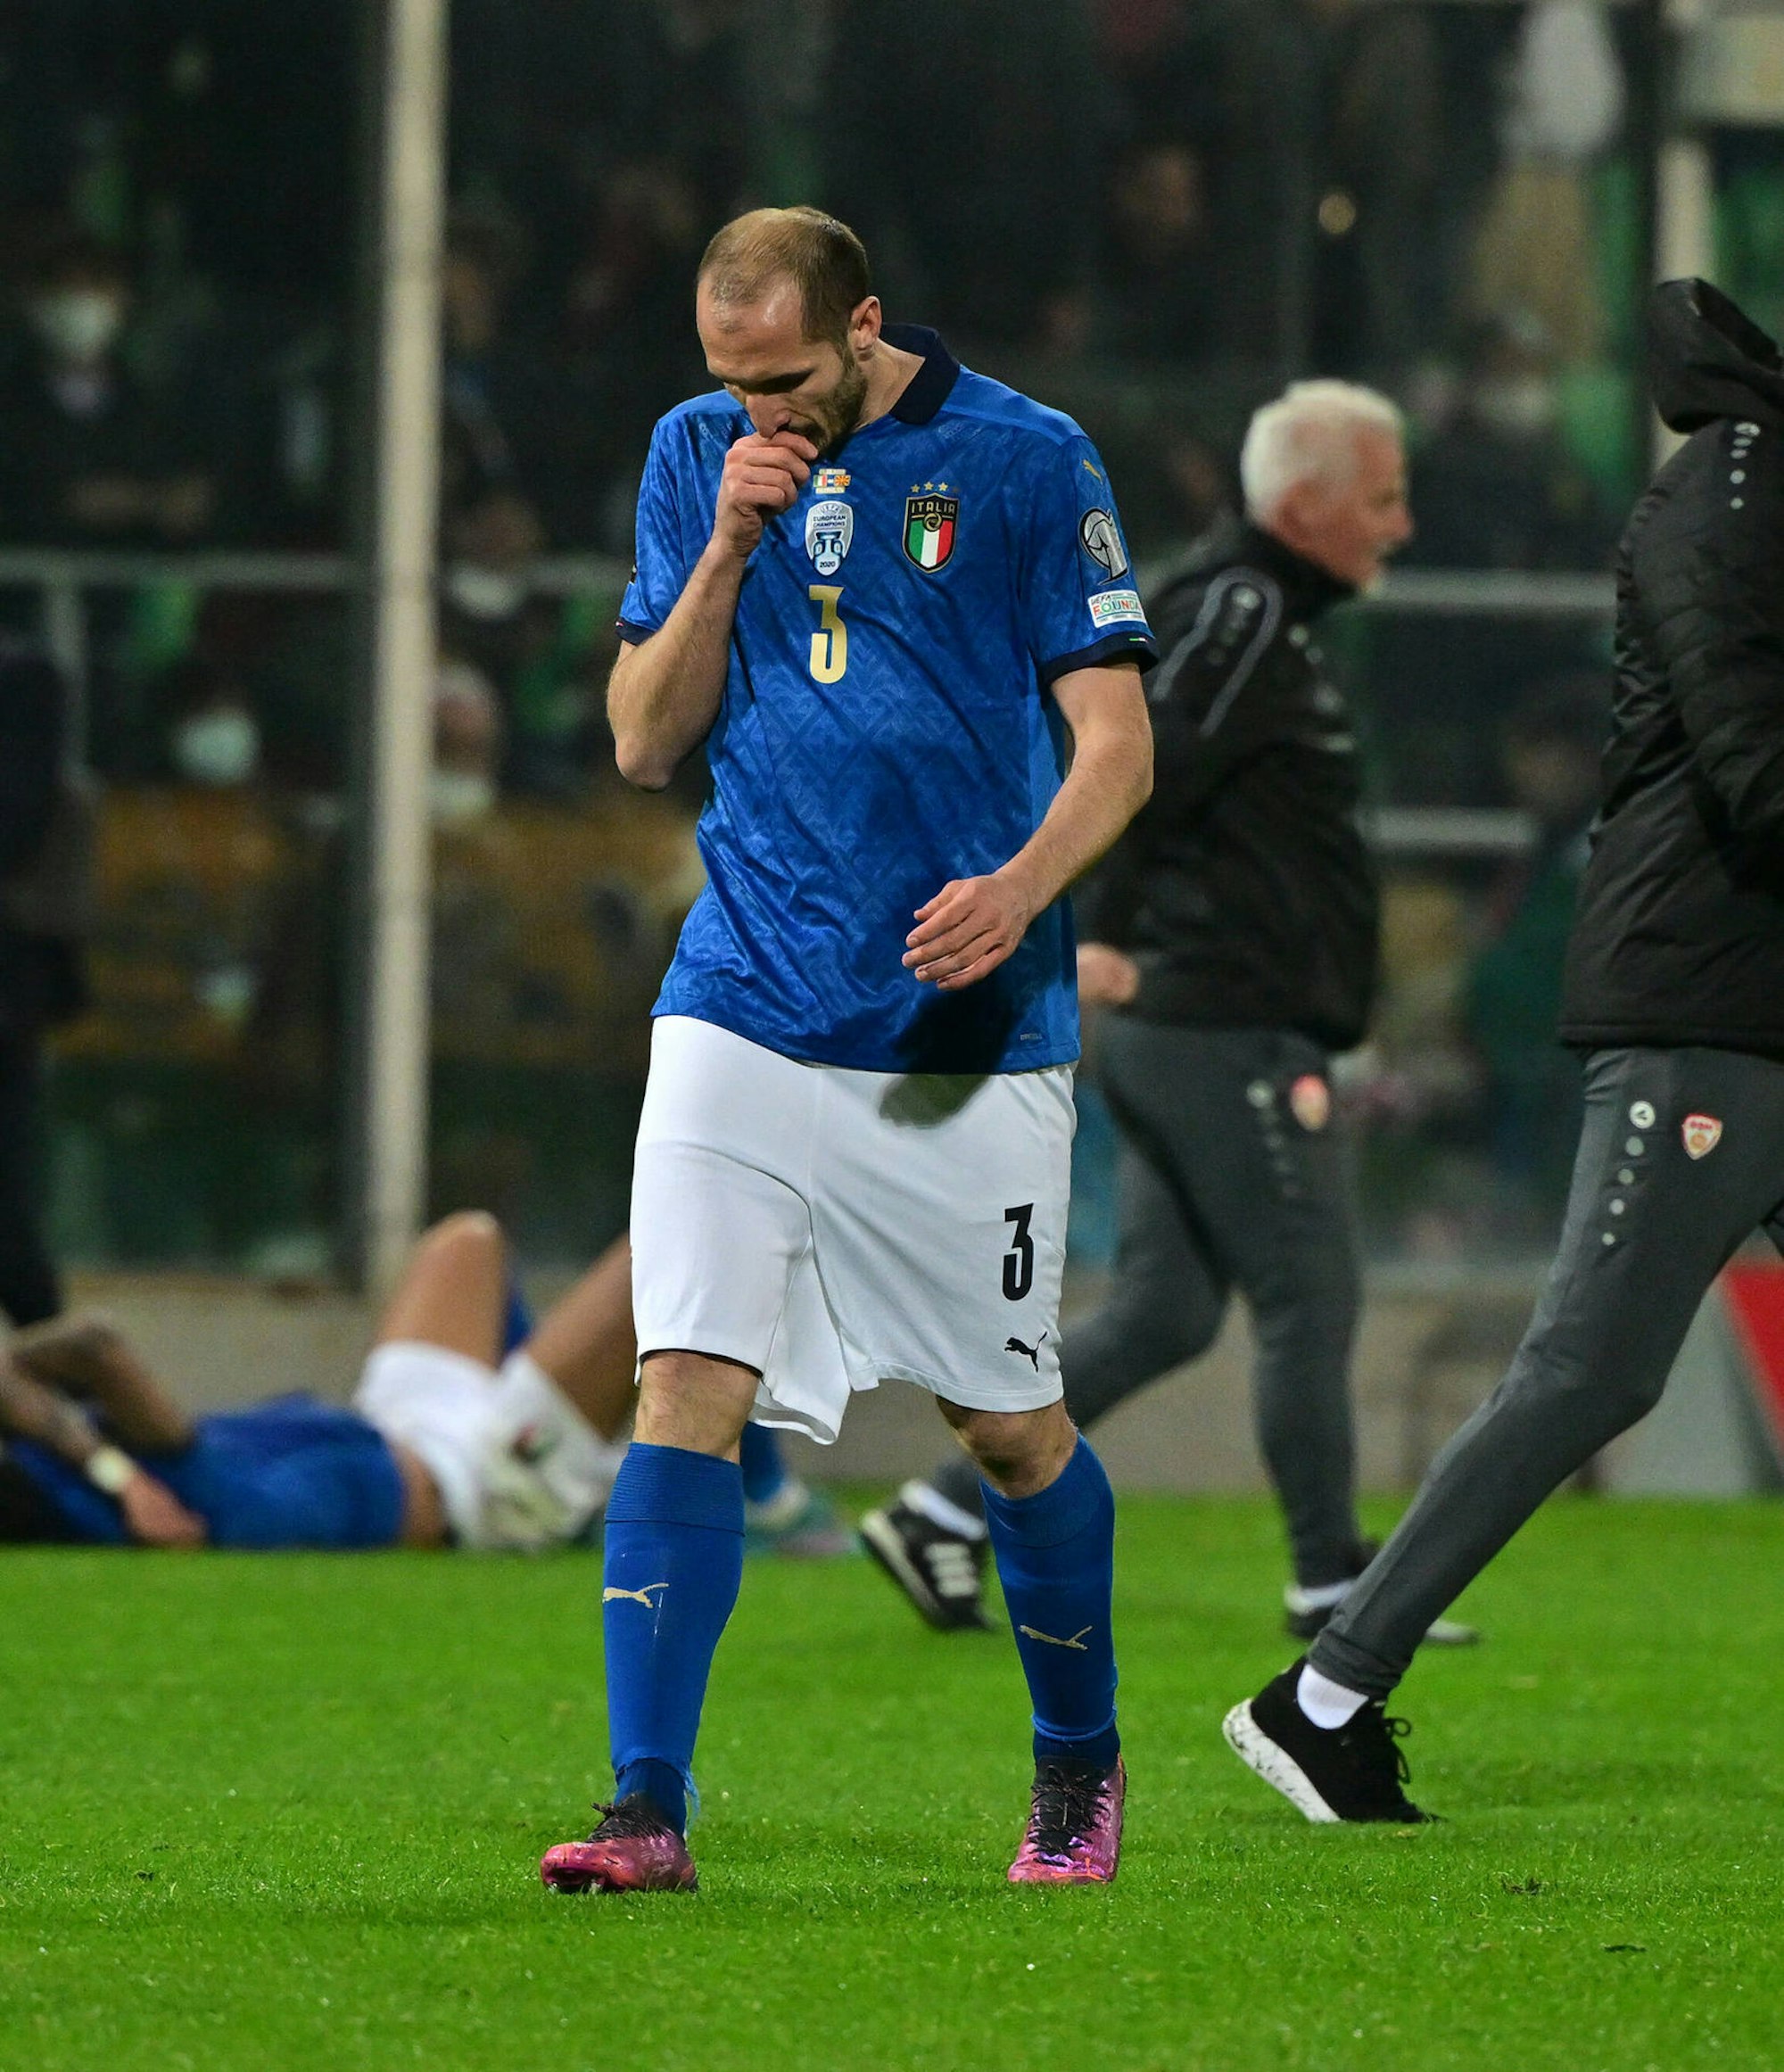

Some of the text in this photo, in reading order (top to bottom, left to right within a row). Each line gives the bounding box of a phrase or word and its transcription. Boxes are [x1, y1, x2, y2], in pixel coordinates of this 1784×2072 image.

[911, 501, 956, 514] ITALIA
[1090, 595, 1111, 605] UEFA
[809, 584, 847, 684] 3
[1002, 1202, 1034, 1300] 3
